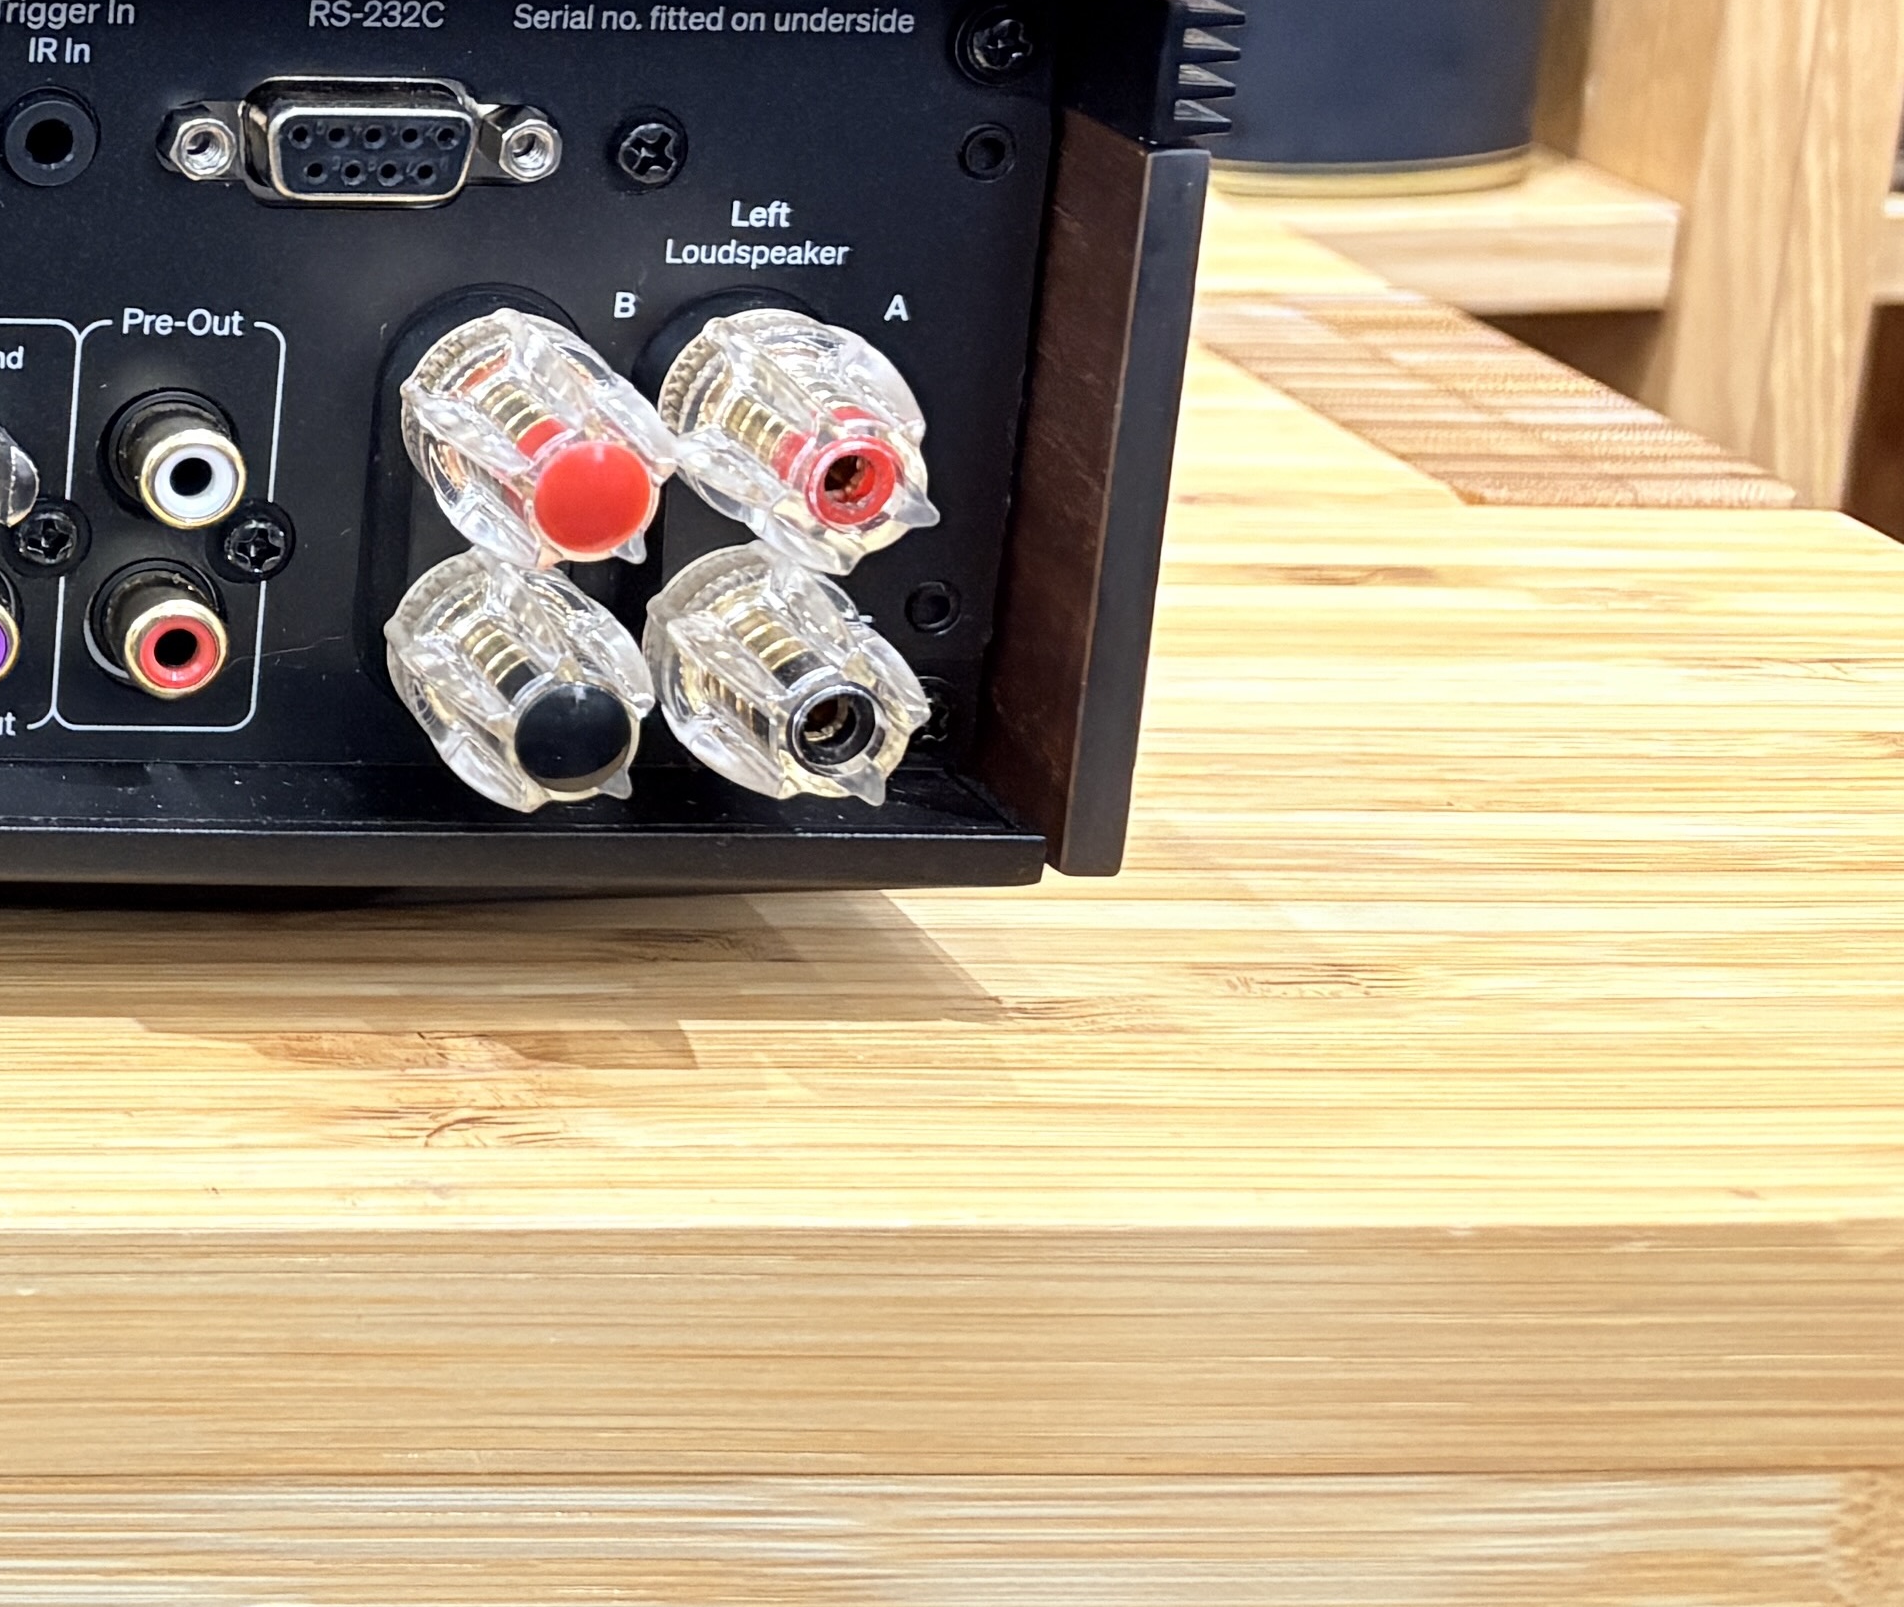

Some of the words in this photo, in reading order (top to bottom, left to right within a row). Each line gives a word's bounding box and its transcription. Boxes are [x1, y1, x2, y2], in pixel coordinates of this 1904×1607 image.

[308, 0, 445, 28] RS-232C
[513, 3, 595, 30] Serial
[601, 10, 643, 31] no.
[649, 4, 725, 32] fitted
[730, 11, 766, 32] on
[773, 6, 915, 34] underside
[28, 36, 58, 63] IR
[64, 37, 91, 64] In
[730, 200, 792, 228] Left
[665, 238, 850, 270] Loudspeaker
[613, 291, 639, 319] B
[883, 294, 909, 322] A
[122, 307, 244, 337] Pre-Out
